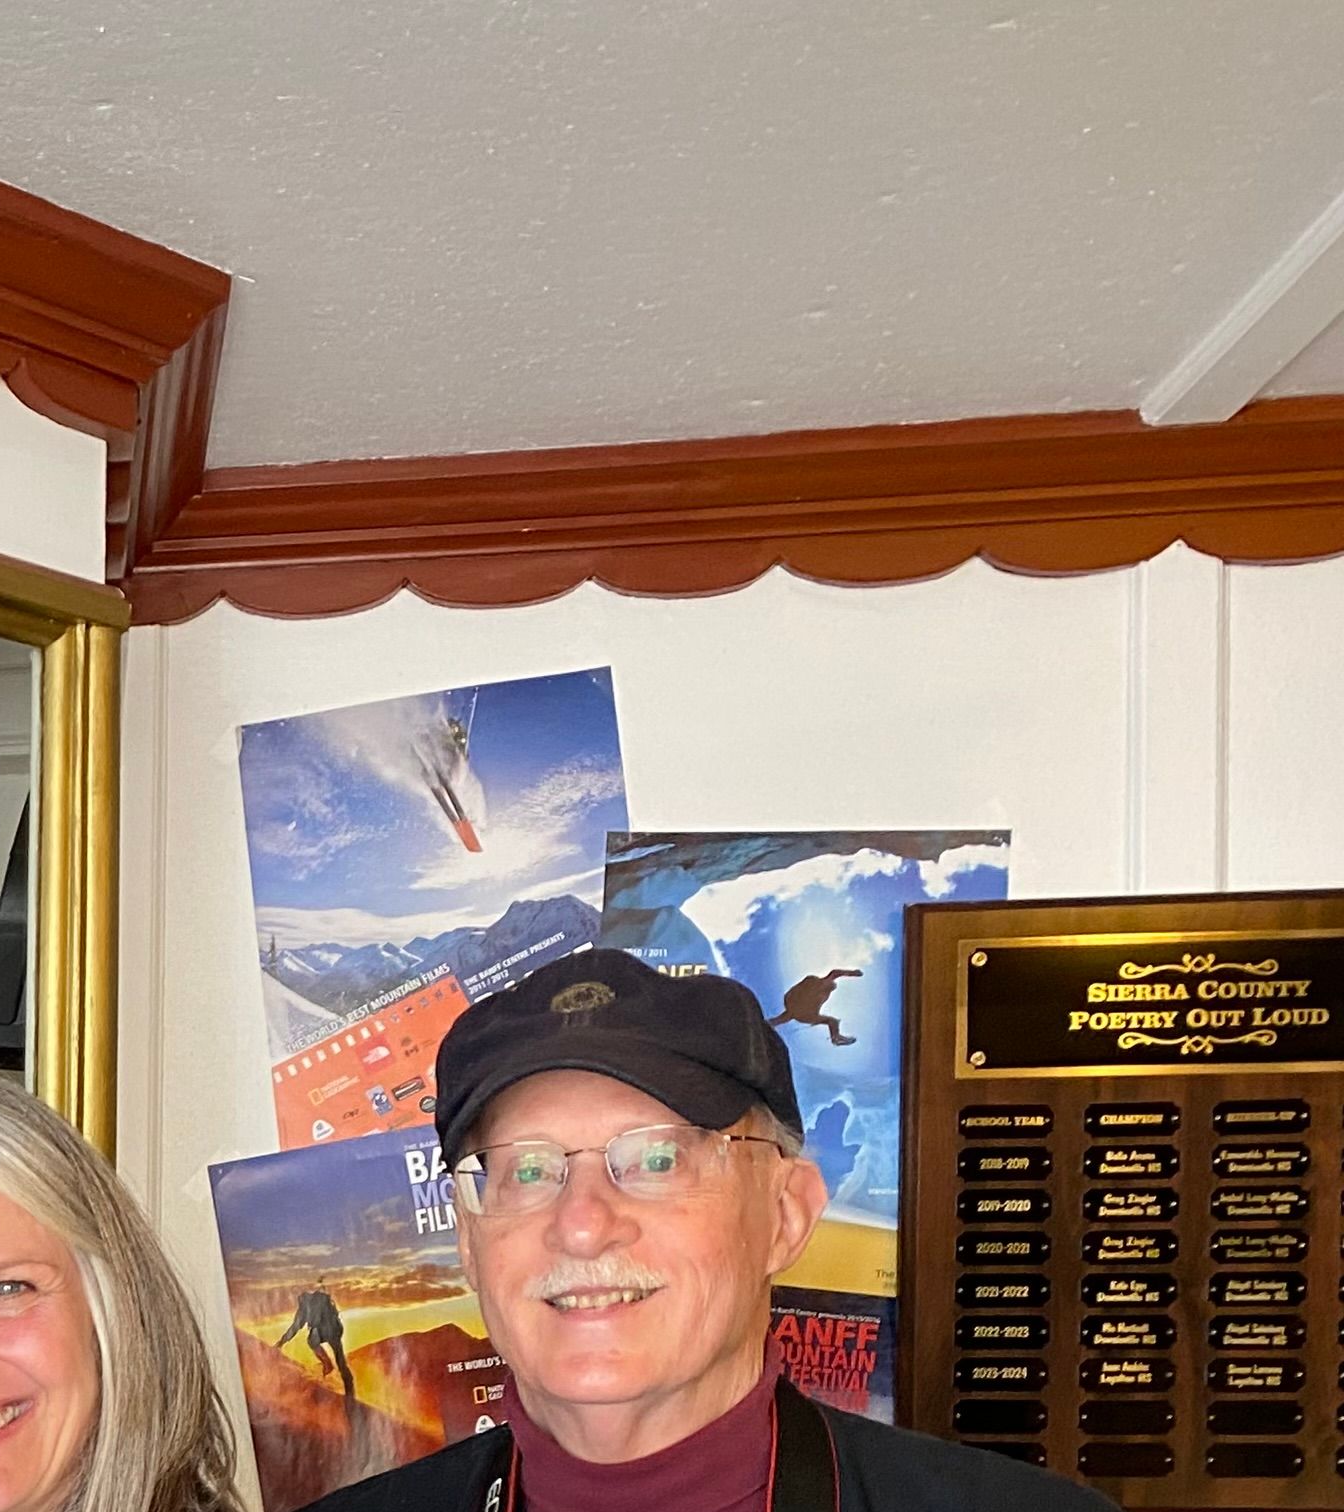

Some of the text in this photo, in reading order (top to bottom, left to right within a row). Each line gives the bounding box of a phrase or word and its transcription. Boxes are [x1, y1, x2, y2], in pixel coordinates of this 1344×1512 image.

[1087, 980, 1312, 1003] SIERRA COUNTY
[287, 963, 450, 1053] THE WORLD'S BEST MOUNTAIN FILMS
[1069, 1007, 1330, 1031] POETRY OUT LOUD
[1014, 1115, 1045, 1126] YEAR
[774, 1314, 881, 1350] ANFF
[447, 1361, 464, 1374] THE
